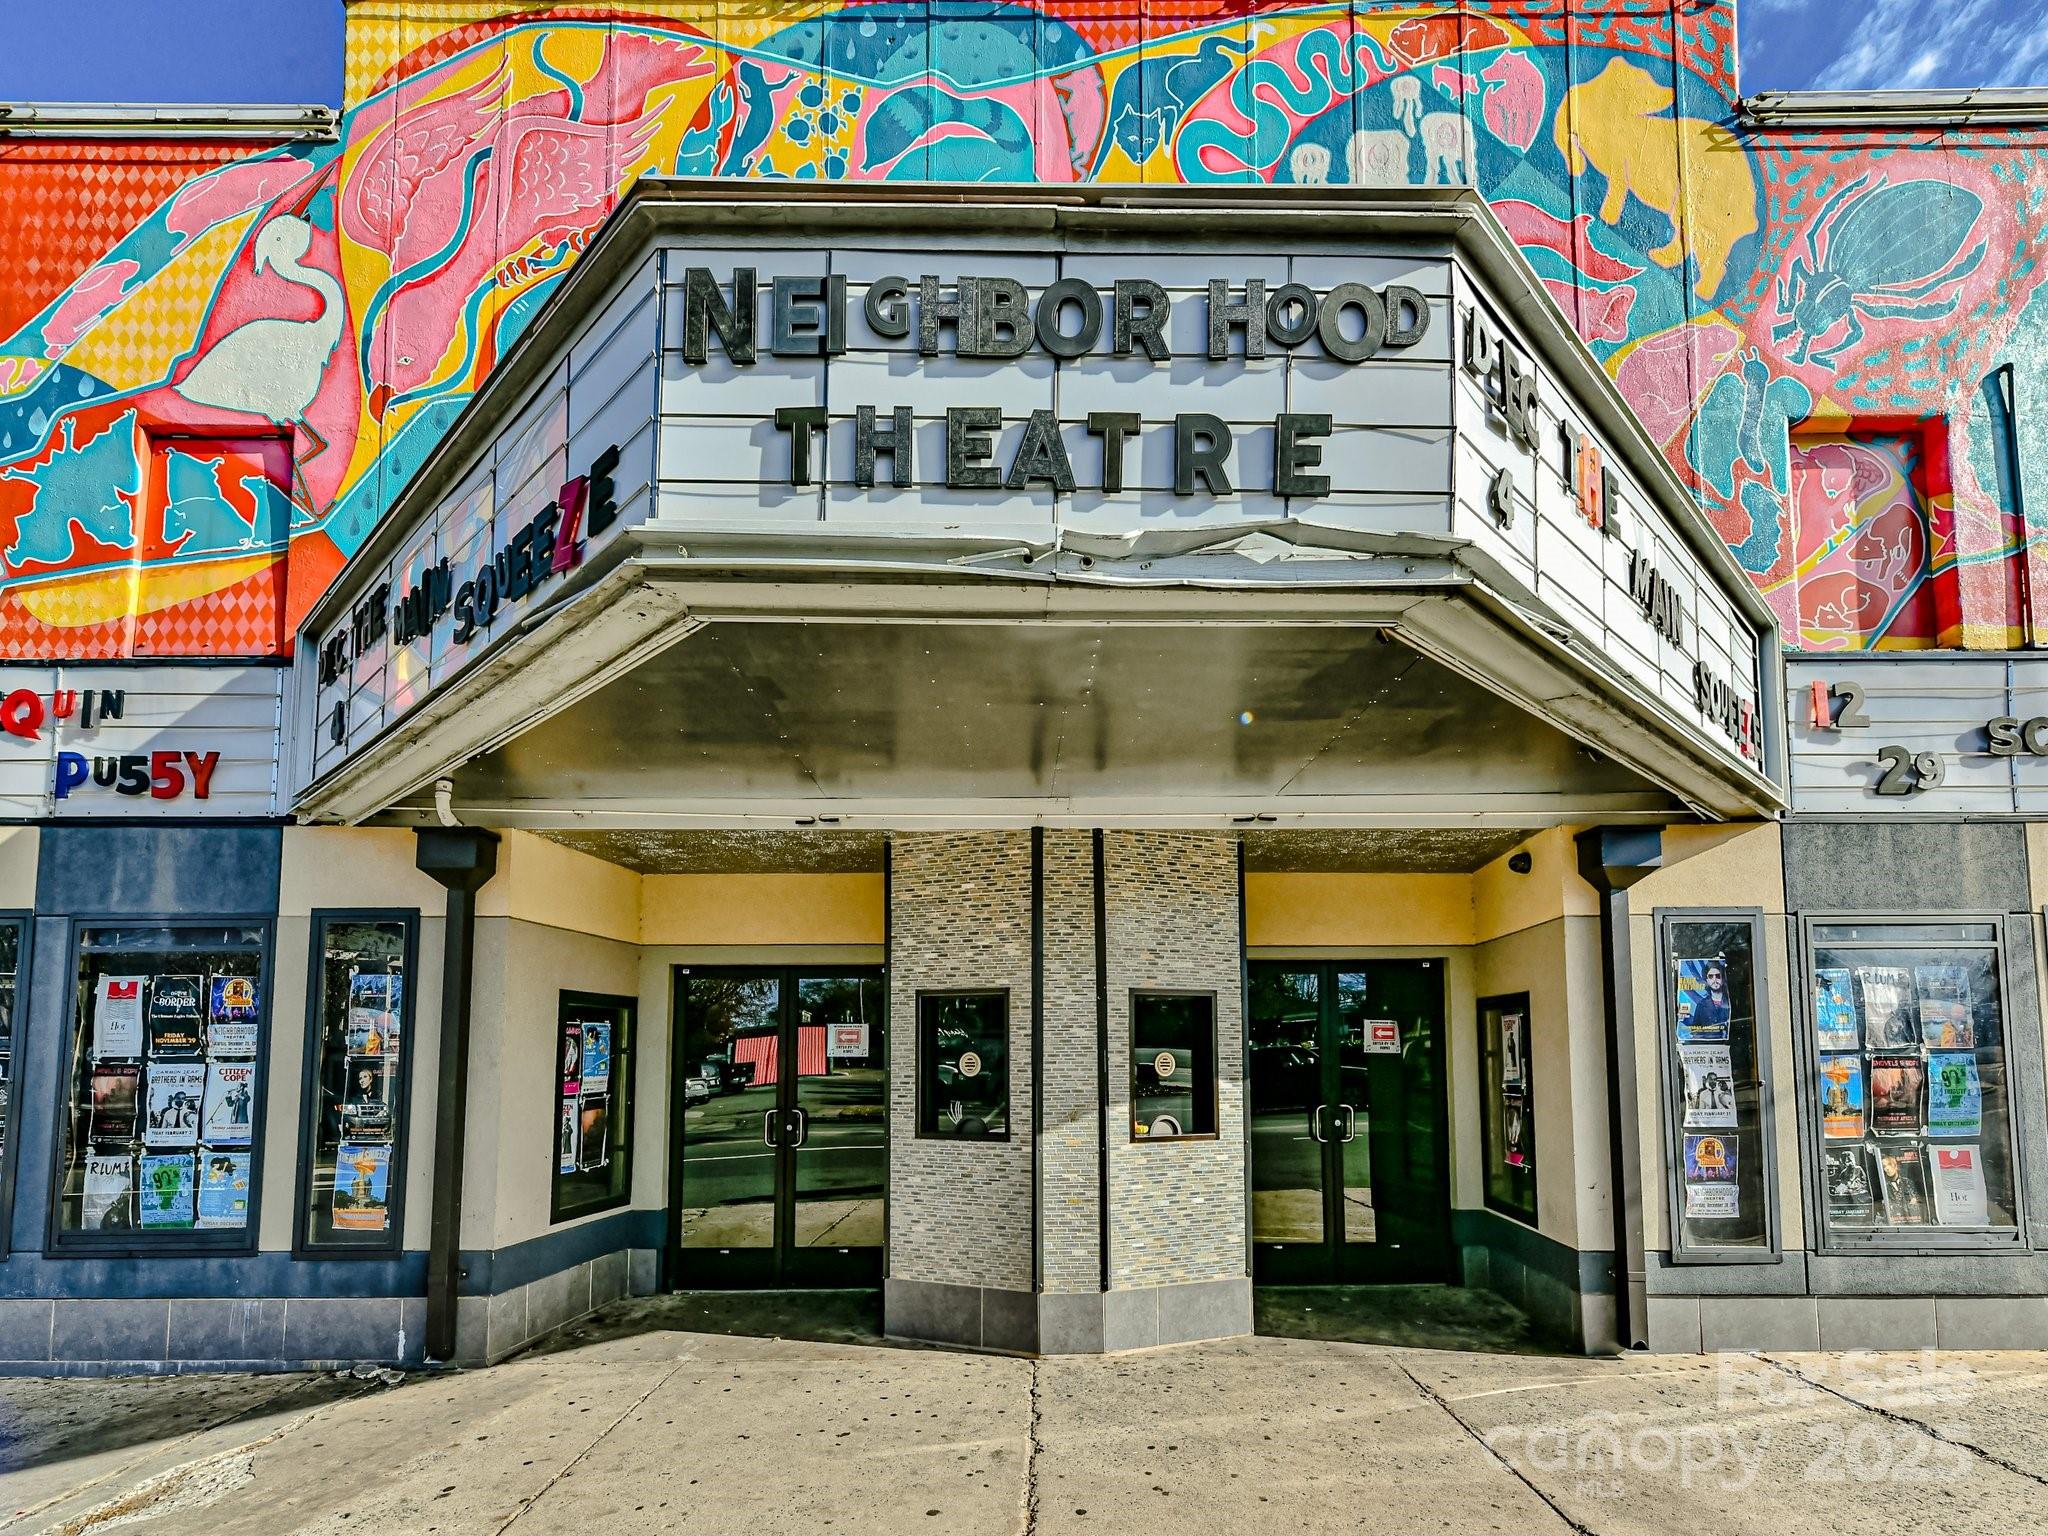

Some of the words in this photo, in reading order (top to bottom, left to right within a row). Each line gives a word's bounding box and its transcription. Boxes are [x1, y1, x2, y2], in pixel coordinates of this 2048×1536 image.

[774, 404, 1333, 498] THEATRE
[1463, 305, 1540, 451] DEC
[1561, 418, 1622, 540] THE
[1488, 467, 1515, 530] 4
[453, 443, 621, 645] SQUEEZE
[353, 582, 388, 659] THE
[393, 556, 451, 646] MAIN
[1628, 548, 1684, 649] MAIN
[0, 688, 126, 740] QUIN
[1693, 660, 1762, 774] SQUEEZE
[1876, 744, 1946, 796] 29
[156, 996, 196, 1010] BORDER
[219, 1068, 253, 1076] CITIZEN
